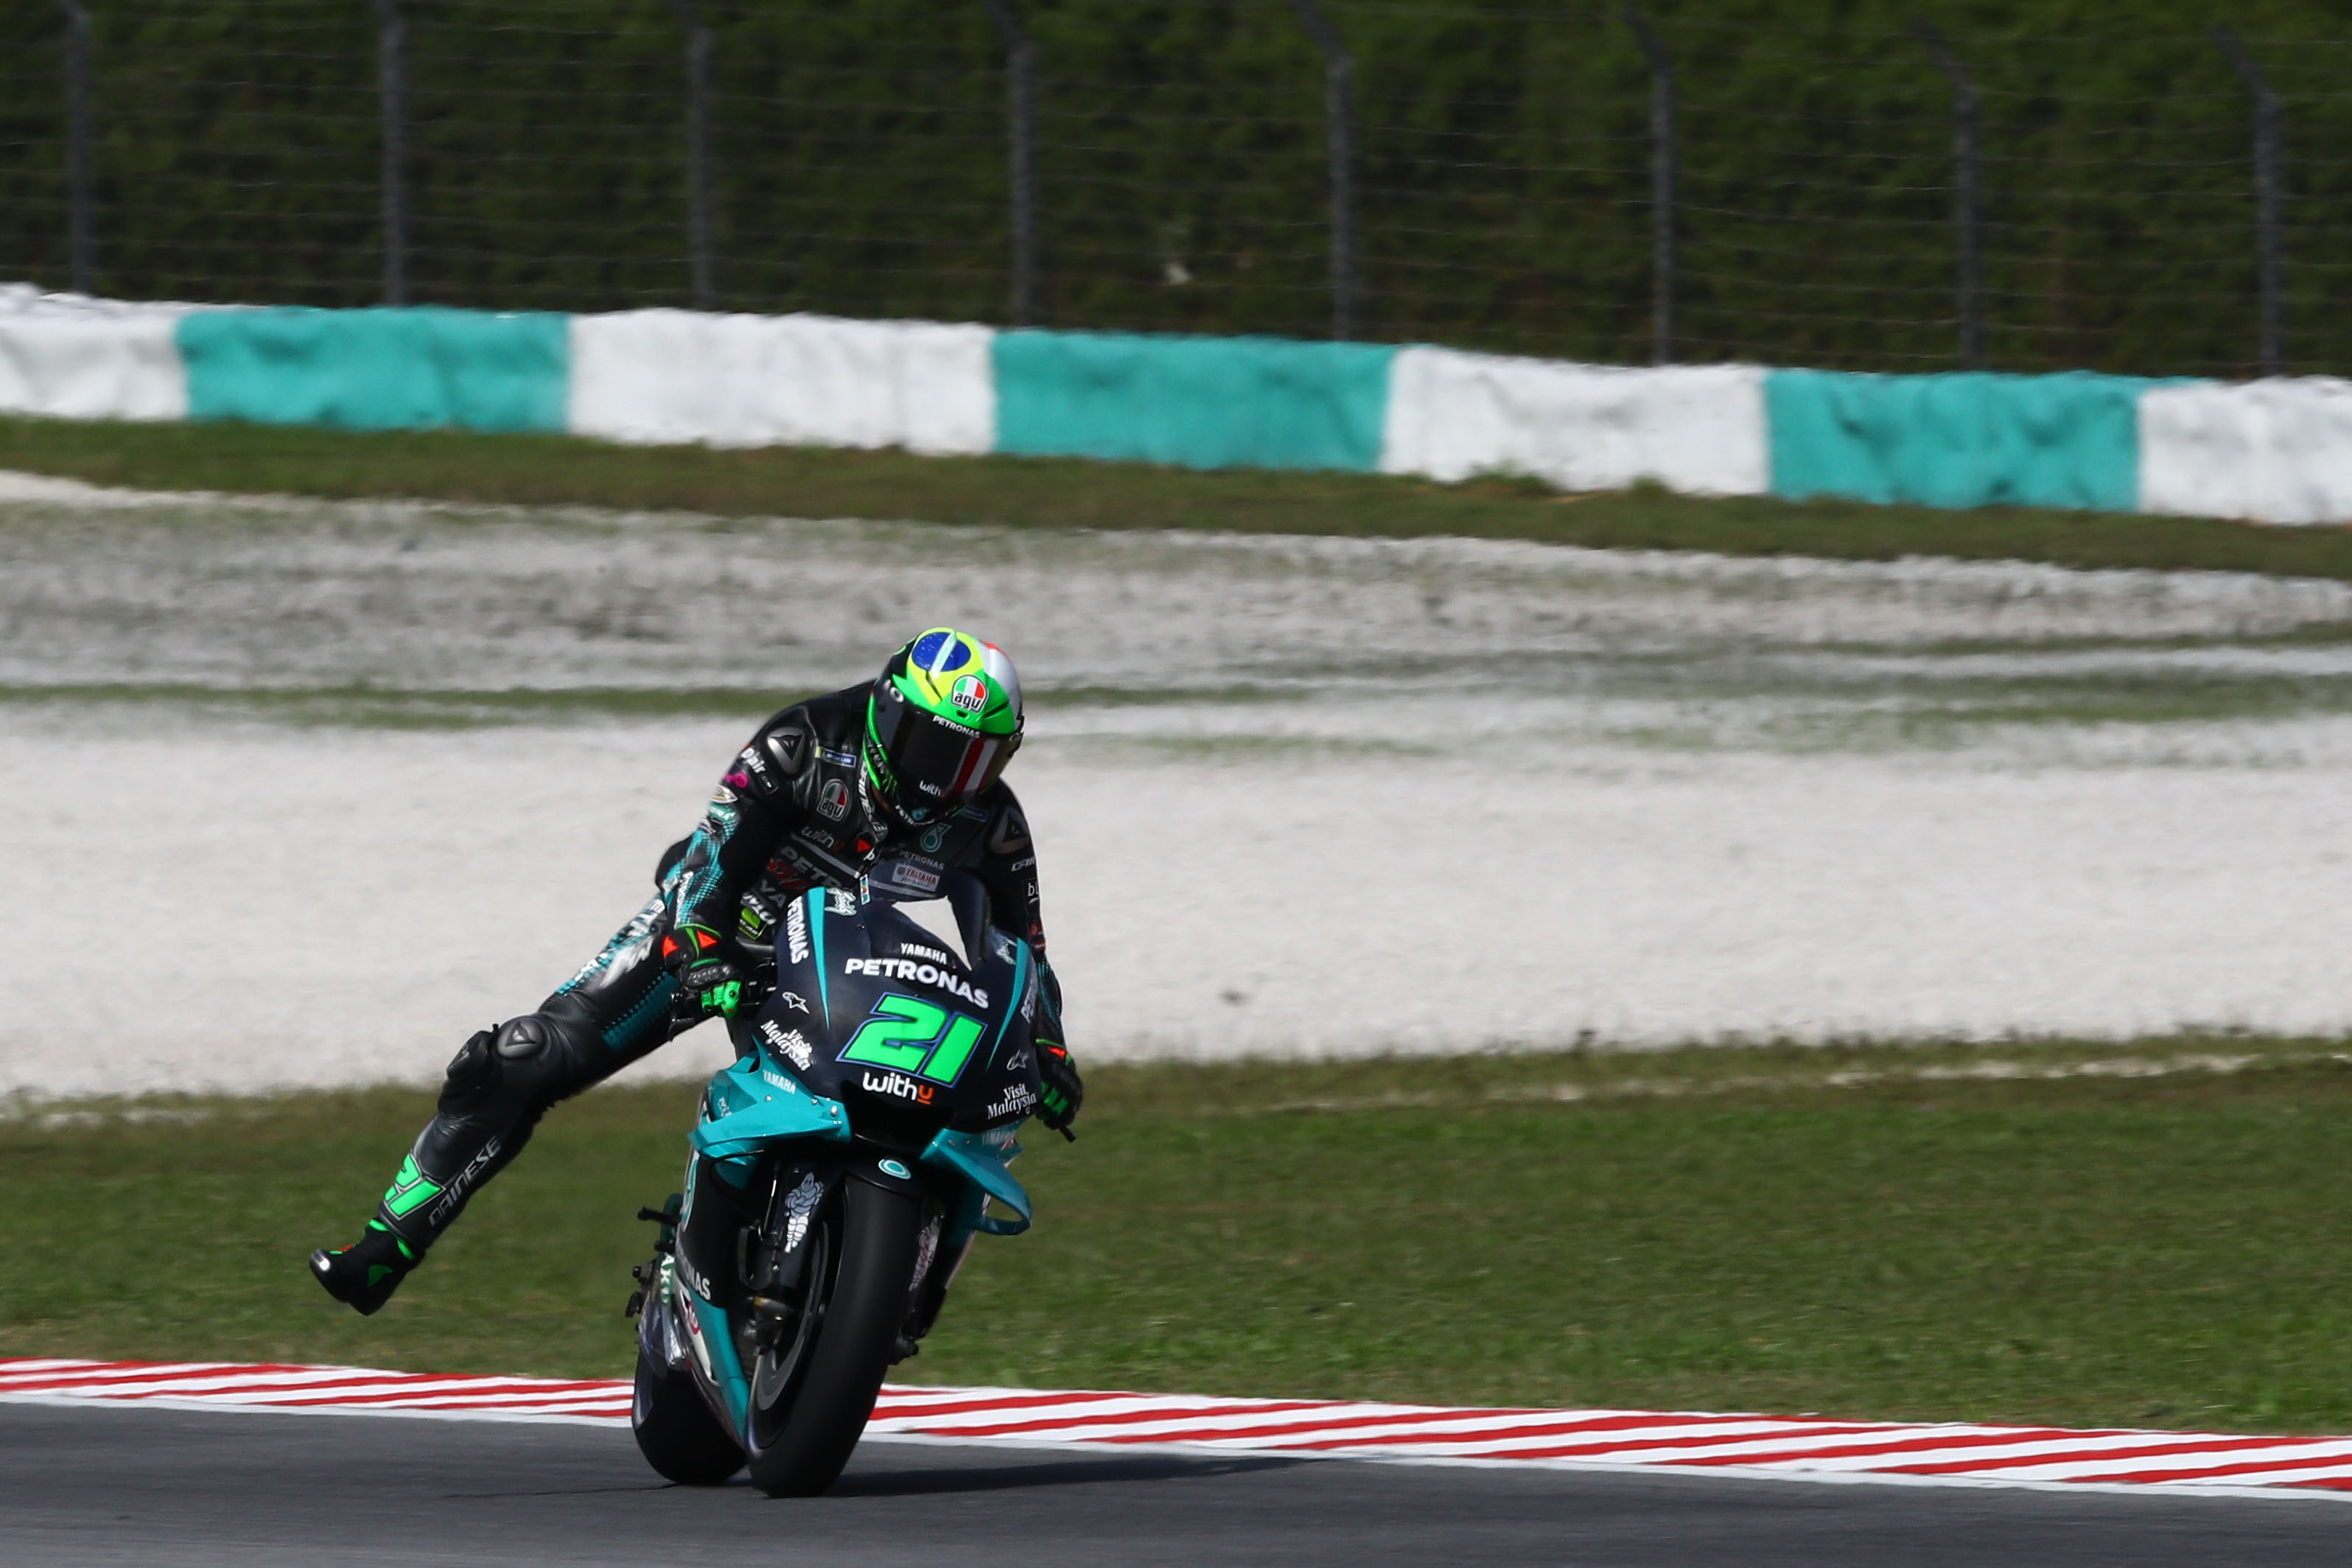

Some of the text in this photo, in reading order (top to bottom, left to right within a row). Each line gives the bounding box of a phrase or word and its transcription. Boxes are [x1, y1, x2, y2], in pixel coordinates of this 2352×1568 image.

[953, 691, 984, 712] agv
[933, 715, 981, 738] PETRONAS
[821, 799, 844, 818] agv
[899, 850, 945, 871] PETRONAS
[787, 896, 809, 965] PETRONAS
[900, 942, 947, 965] YAMAHA
[844, 958, 990, 1009] PETRONAS
[760, 1020, 811, 1071] Malaysia
[836, 992, 988, 1088] 21
[763, 1069, 797, 1095] YAMAHA
[1003, 1082, 1028, 1101] Visit
[987, 1092, 1037, 1120] Malaysia
[427, 1136, 502, 1227] DAINESE
